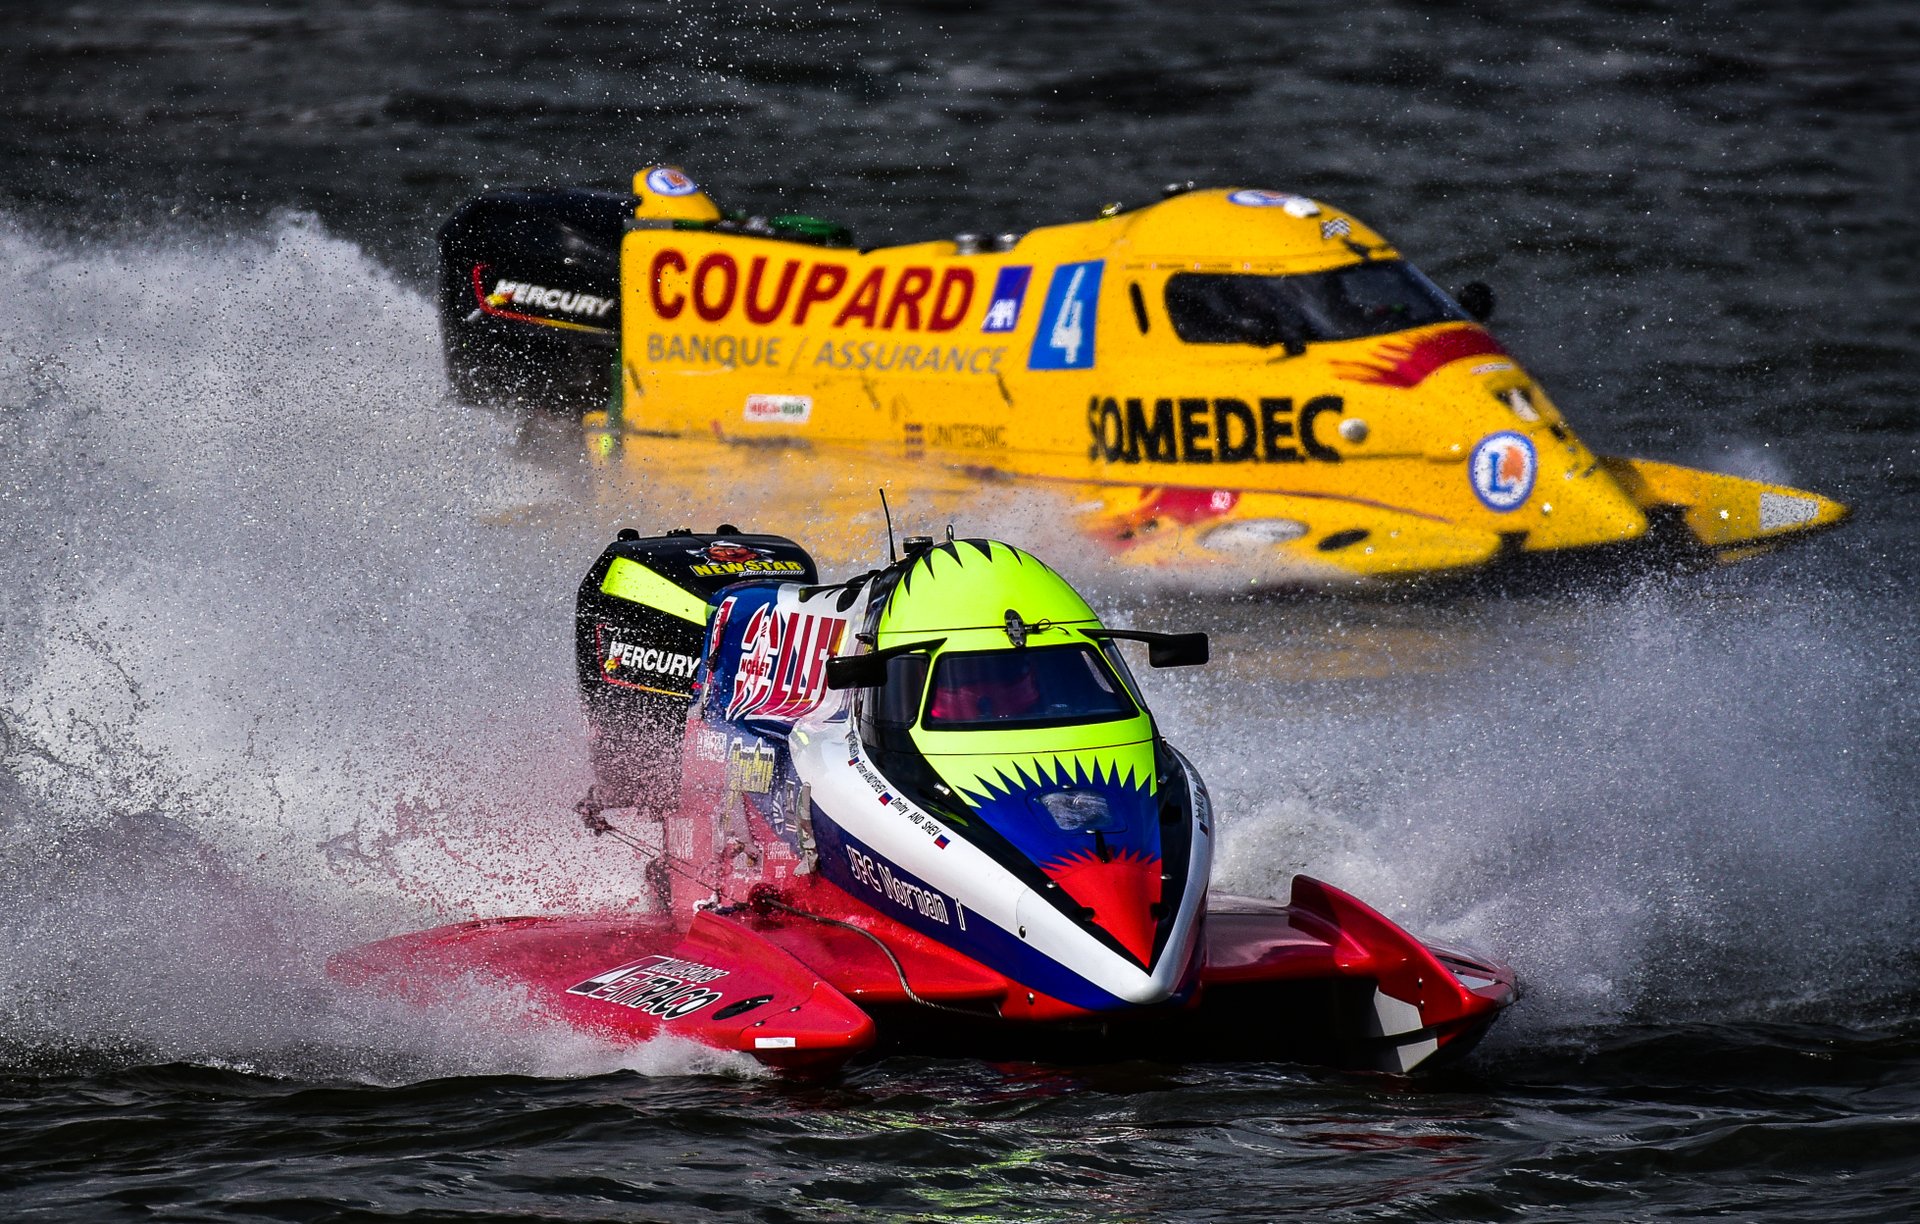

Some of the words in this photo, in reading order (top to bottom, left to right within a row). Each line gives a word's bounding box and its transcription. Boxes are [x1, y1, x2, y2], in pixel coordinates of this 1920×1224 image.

[494, 279, 615, 317] MERCURY
[650, 249, 976, 332] COUPARD
[1049, 266, 1086, 364] 4
[647, 333, 783, 369] BANQUE
[812, 340, 1008, 374] ASSURANCE
[1088, 394, 1344, 463] SOMEDEC
[608, 641, 701, 678] MERCURY
[877, 862, 949, 925] Norman
